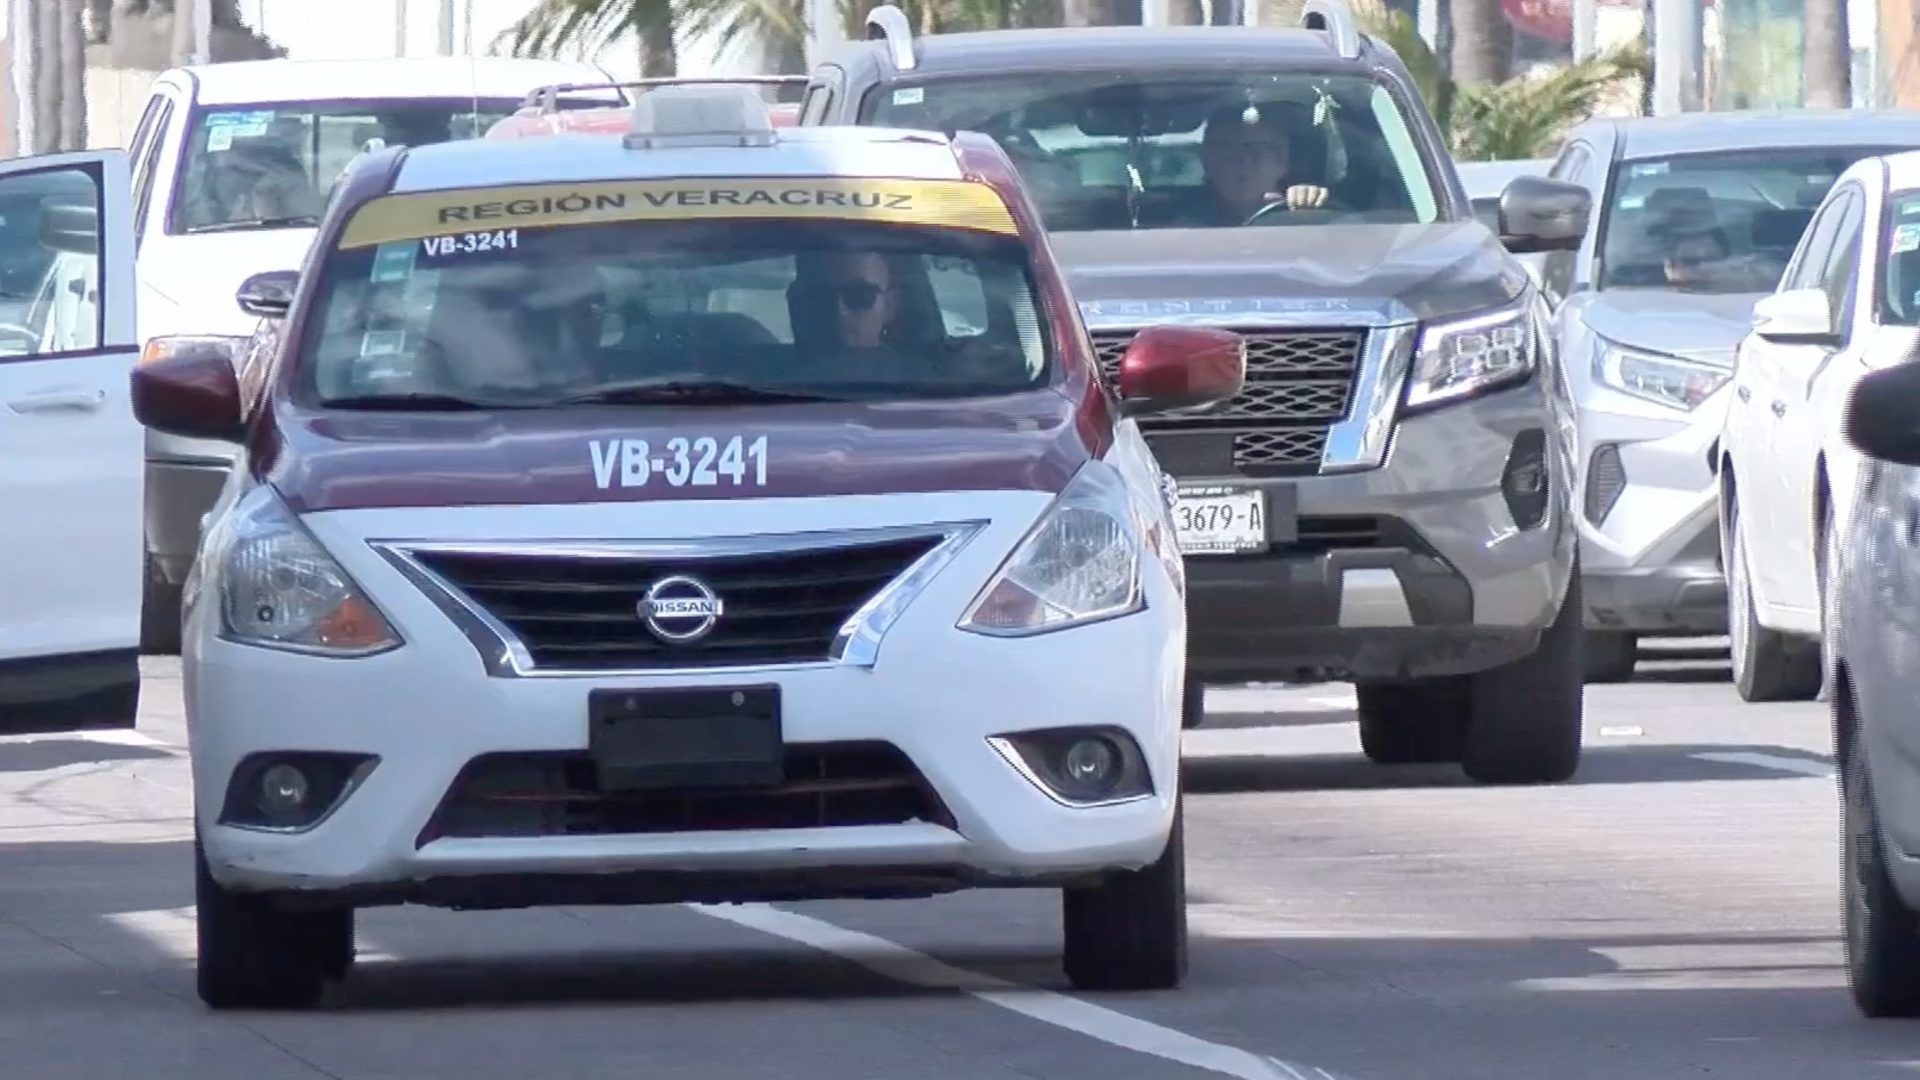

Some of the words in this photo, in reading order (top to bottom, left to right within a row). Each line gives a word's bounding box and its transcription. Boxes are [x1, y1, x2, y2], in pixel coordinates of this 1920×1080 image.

[438, 192, 626, 224] REGIÓN
[643, 189, 913, 210] VERACRUZ
[422, 230, 520, 257] VB-3241
[588, 435, 768, 490] VB-3241
[649, 601, 713, 614] NISSAN
